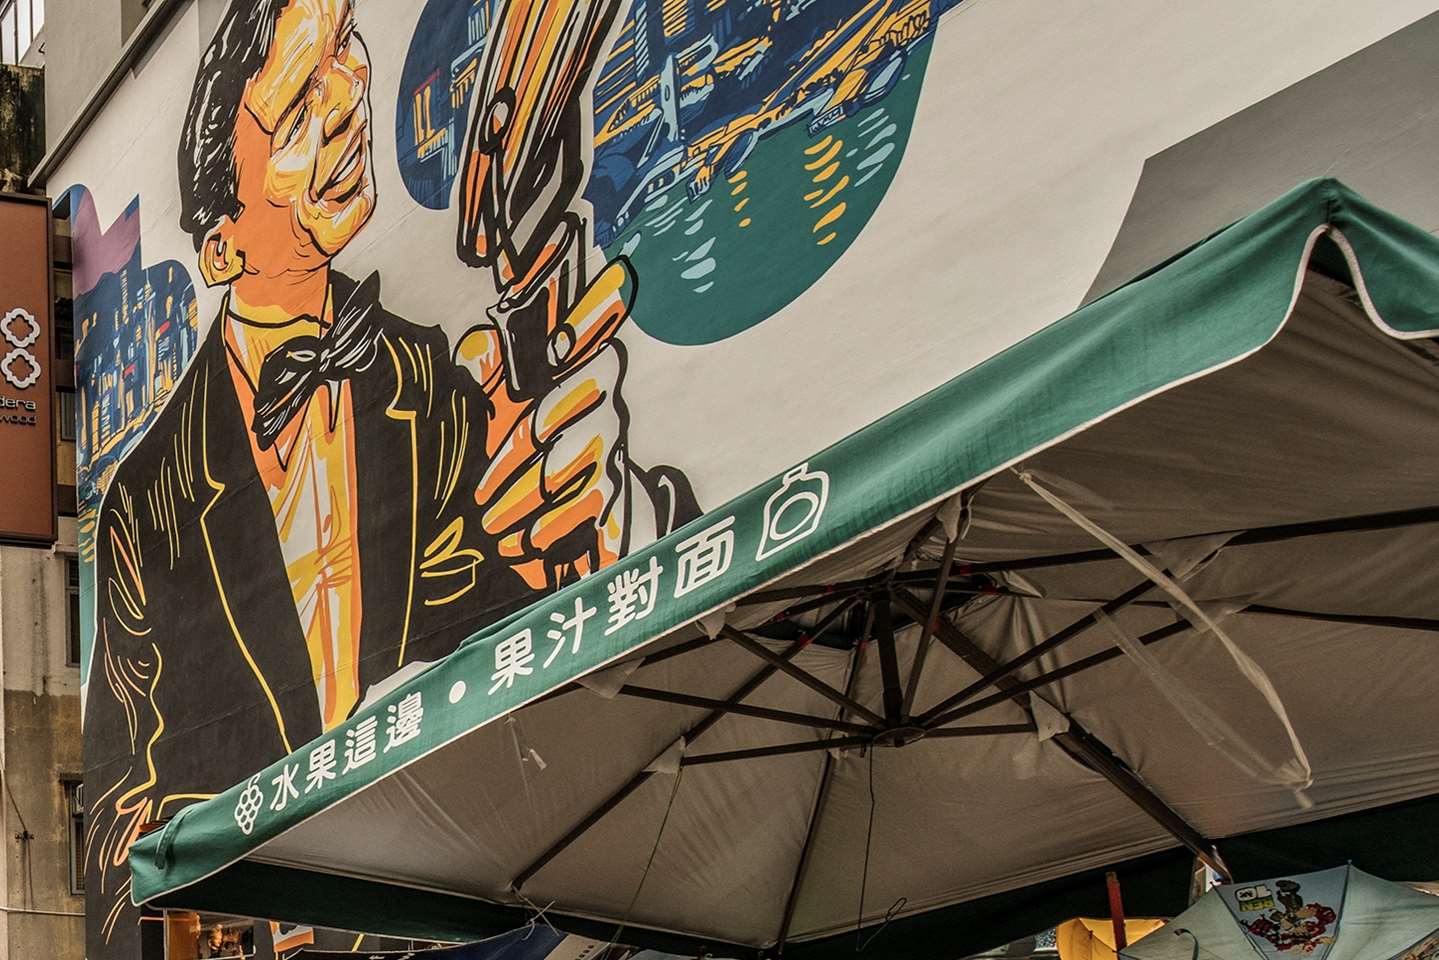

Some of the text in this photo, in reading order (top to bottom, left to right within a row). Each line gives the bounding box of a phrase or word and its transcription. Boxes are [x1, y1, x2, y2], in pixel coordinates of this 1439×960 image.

[270, 515, 736, 812] 水果這邊 果汁對面
